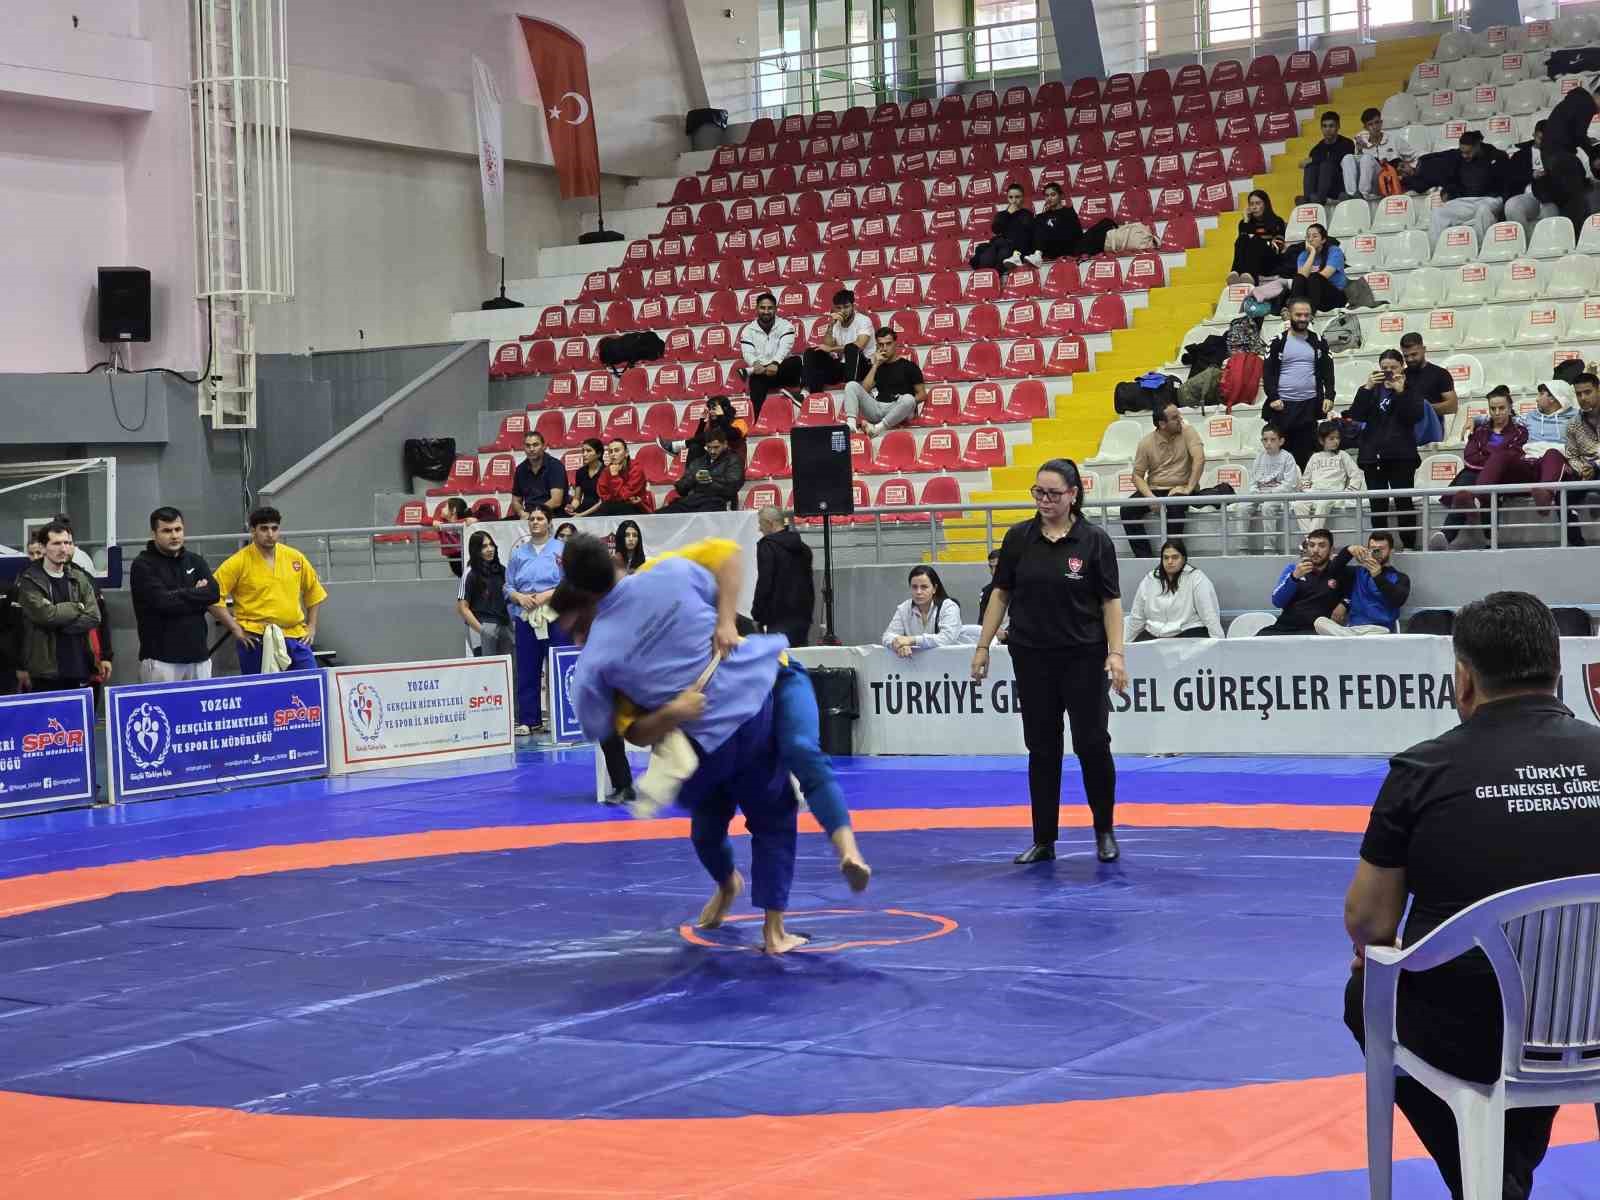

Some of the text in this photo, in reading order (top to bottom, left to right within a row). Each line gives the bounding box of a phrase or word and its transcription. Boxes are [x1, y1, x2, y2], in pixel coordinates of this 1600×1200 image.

[408, 679, 439, 692] YOZGAT
[870, 672, 984, 715] TÜRKİYE
[1173, 668, 1330, 720] GÜREŞLER
[200, 696, 242, 712] YOZGAT
[175, 713, 268, 735] GENÇLİK HİZMETLERİ
[274, 706, 321, 727] SPOR
[22, 729, 84, 753] SPOR
[171, 731, 273, 754] VE SPOR İL MÜDÜRLÜĞÜ
[0, 756, 21, 772] ÜĞÜ
[1515, 763, 1588, 780] TÜRKİYE
[1475, 778, 1600, 799] GELENEKSEL GÜRE
